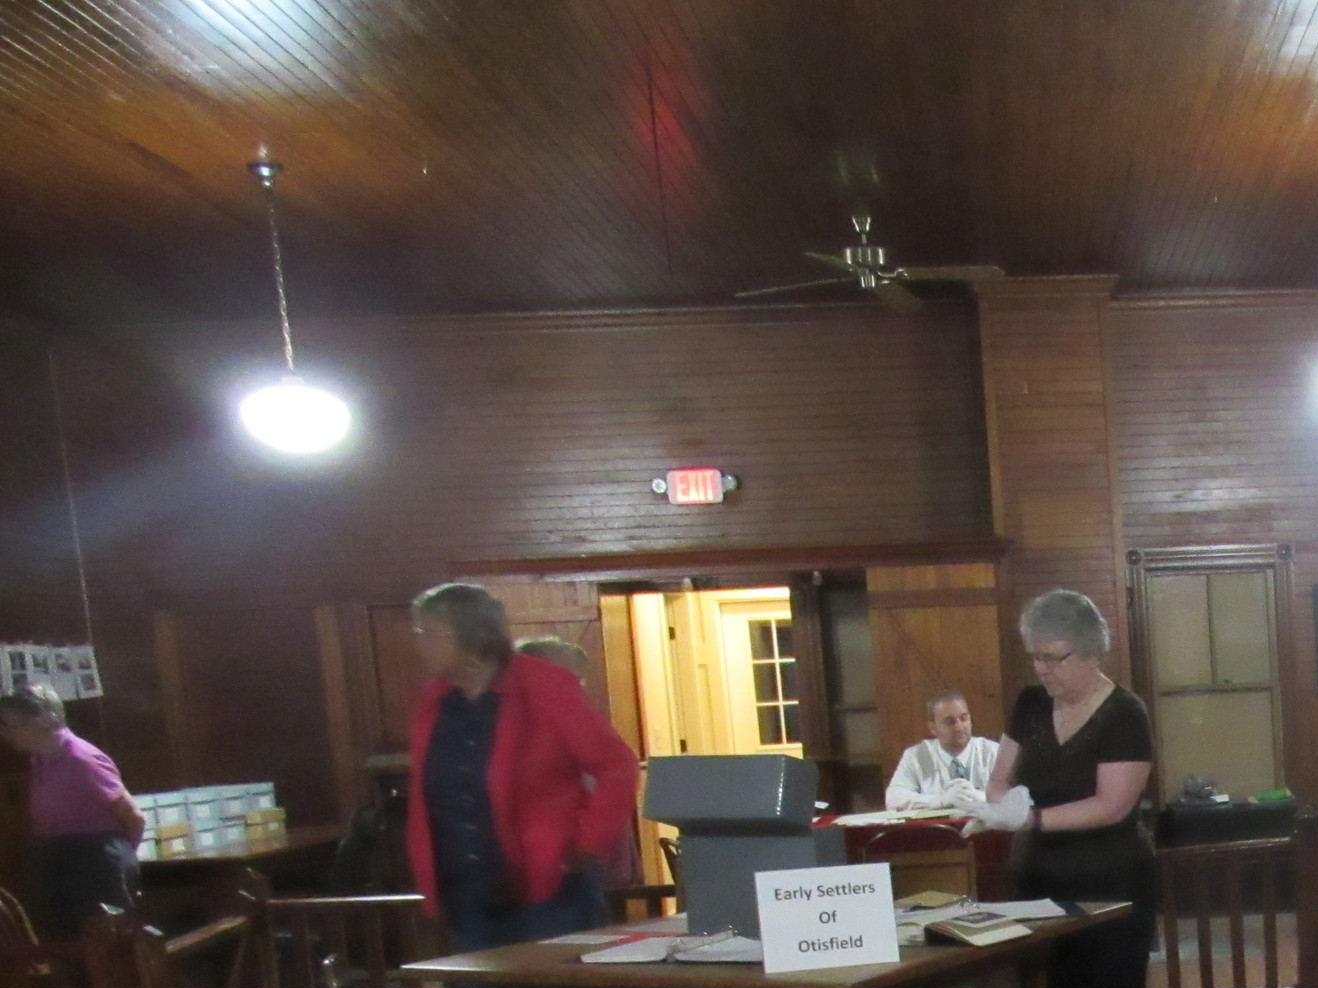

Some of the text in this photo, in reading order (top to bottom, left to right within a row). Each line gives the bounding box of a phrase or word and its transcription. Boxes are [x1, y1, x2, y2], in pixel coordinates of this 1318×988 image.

[675, 470, 714, 502] EXIT
[774, 882, 876, 901] Early Settlers
[818, 910, 837, 924] Of
[798, 935, 864, 953] Otisfield
